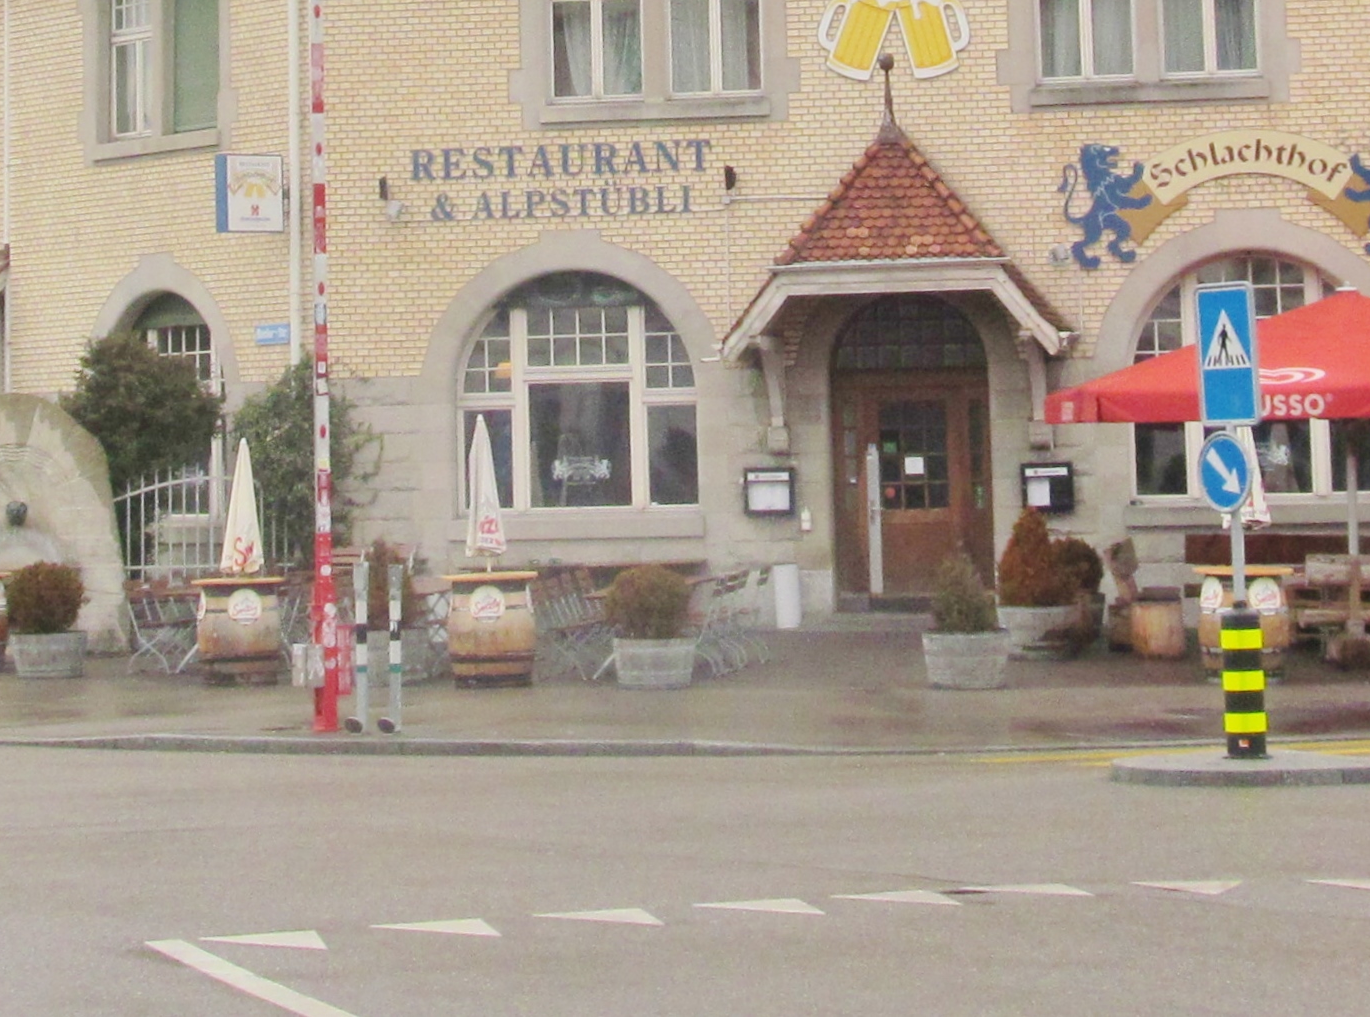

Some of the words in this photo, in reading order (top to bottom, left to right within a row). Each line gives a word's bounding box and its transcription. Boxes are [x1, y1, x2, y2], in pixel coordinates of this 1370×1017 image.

[410, 138, 711, 182] RESTAURANT
[1149, 138, 1348, 188] Schlachthof
[430, 192, 456, 222] &
[471, 180, 694, 220] ALPSTÜBLI
[1260, 393, 1326, 417] USSO
